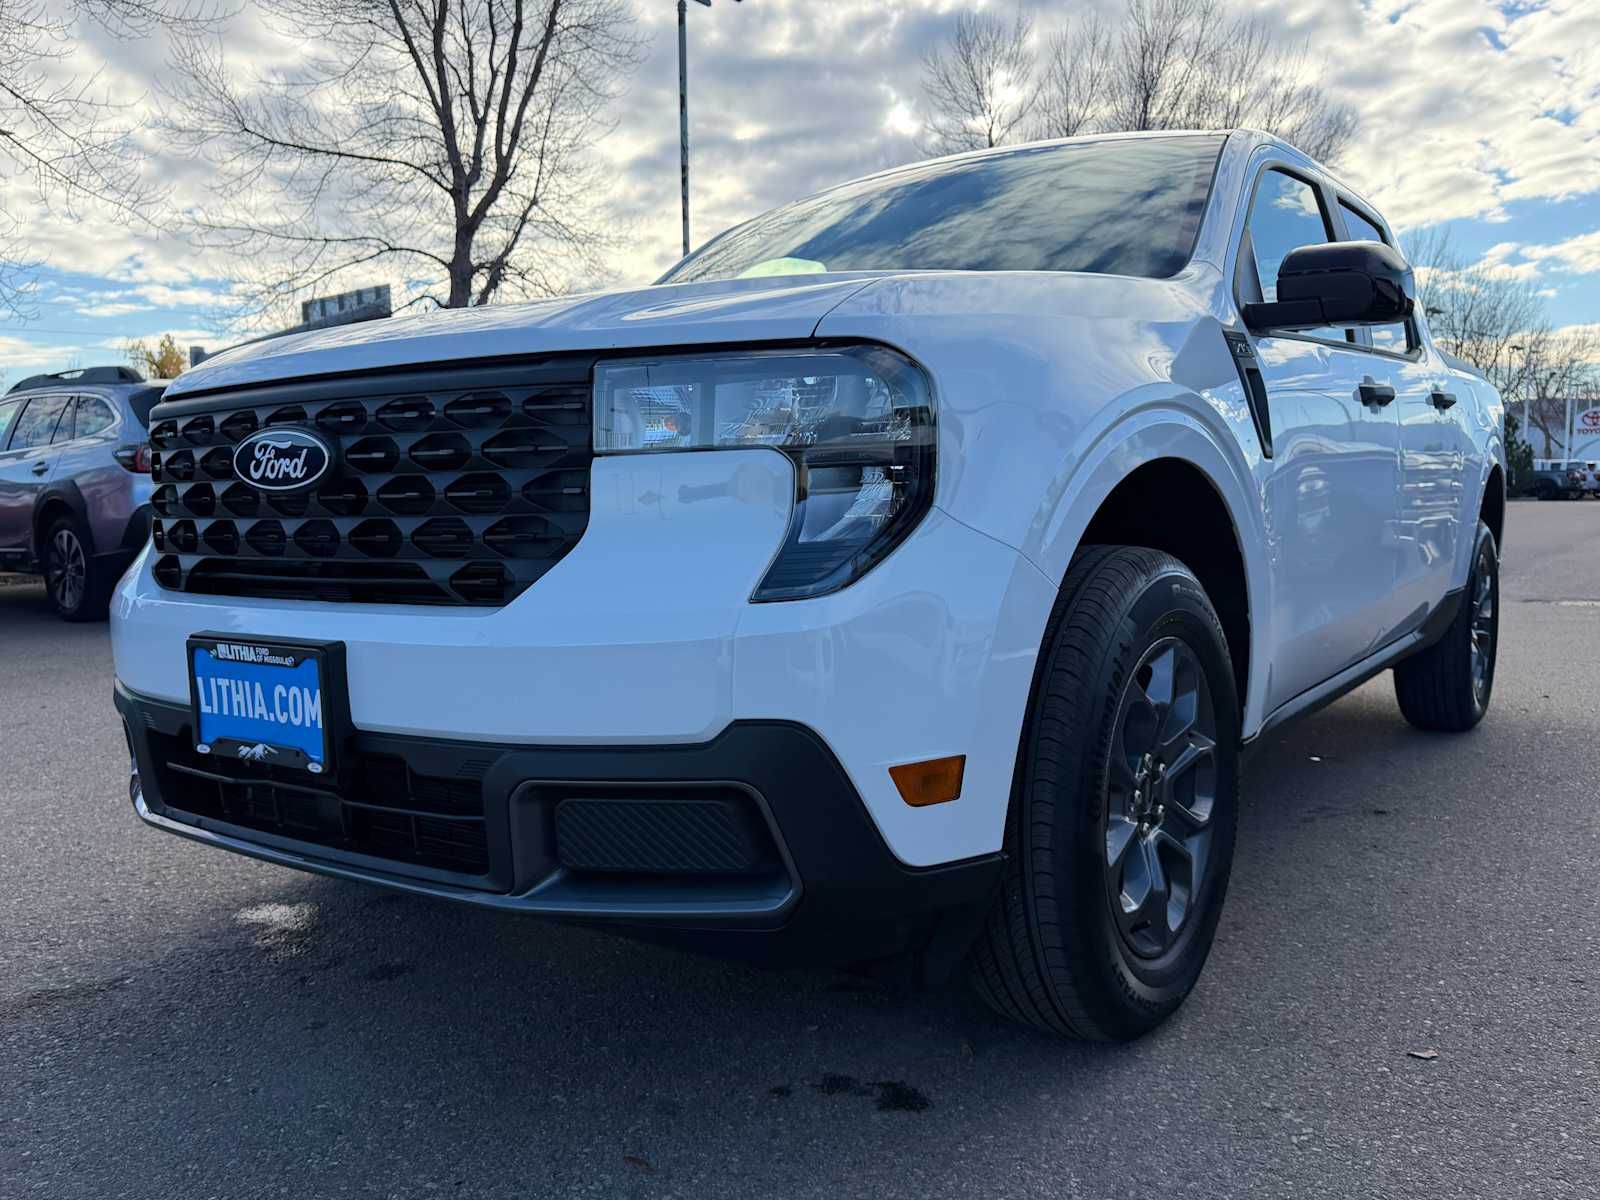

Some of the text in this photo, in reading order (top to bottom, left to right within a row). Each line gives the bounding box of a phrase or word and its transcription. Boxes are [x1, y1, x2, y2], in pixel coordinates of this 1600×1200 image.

[250, 440, 307, 480] Ford
[225, 644, 257, 662] LITHIA
[196, 676, 323, 729] LITHIA.COM
